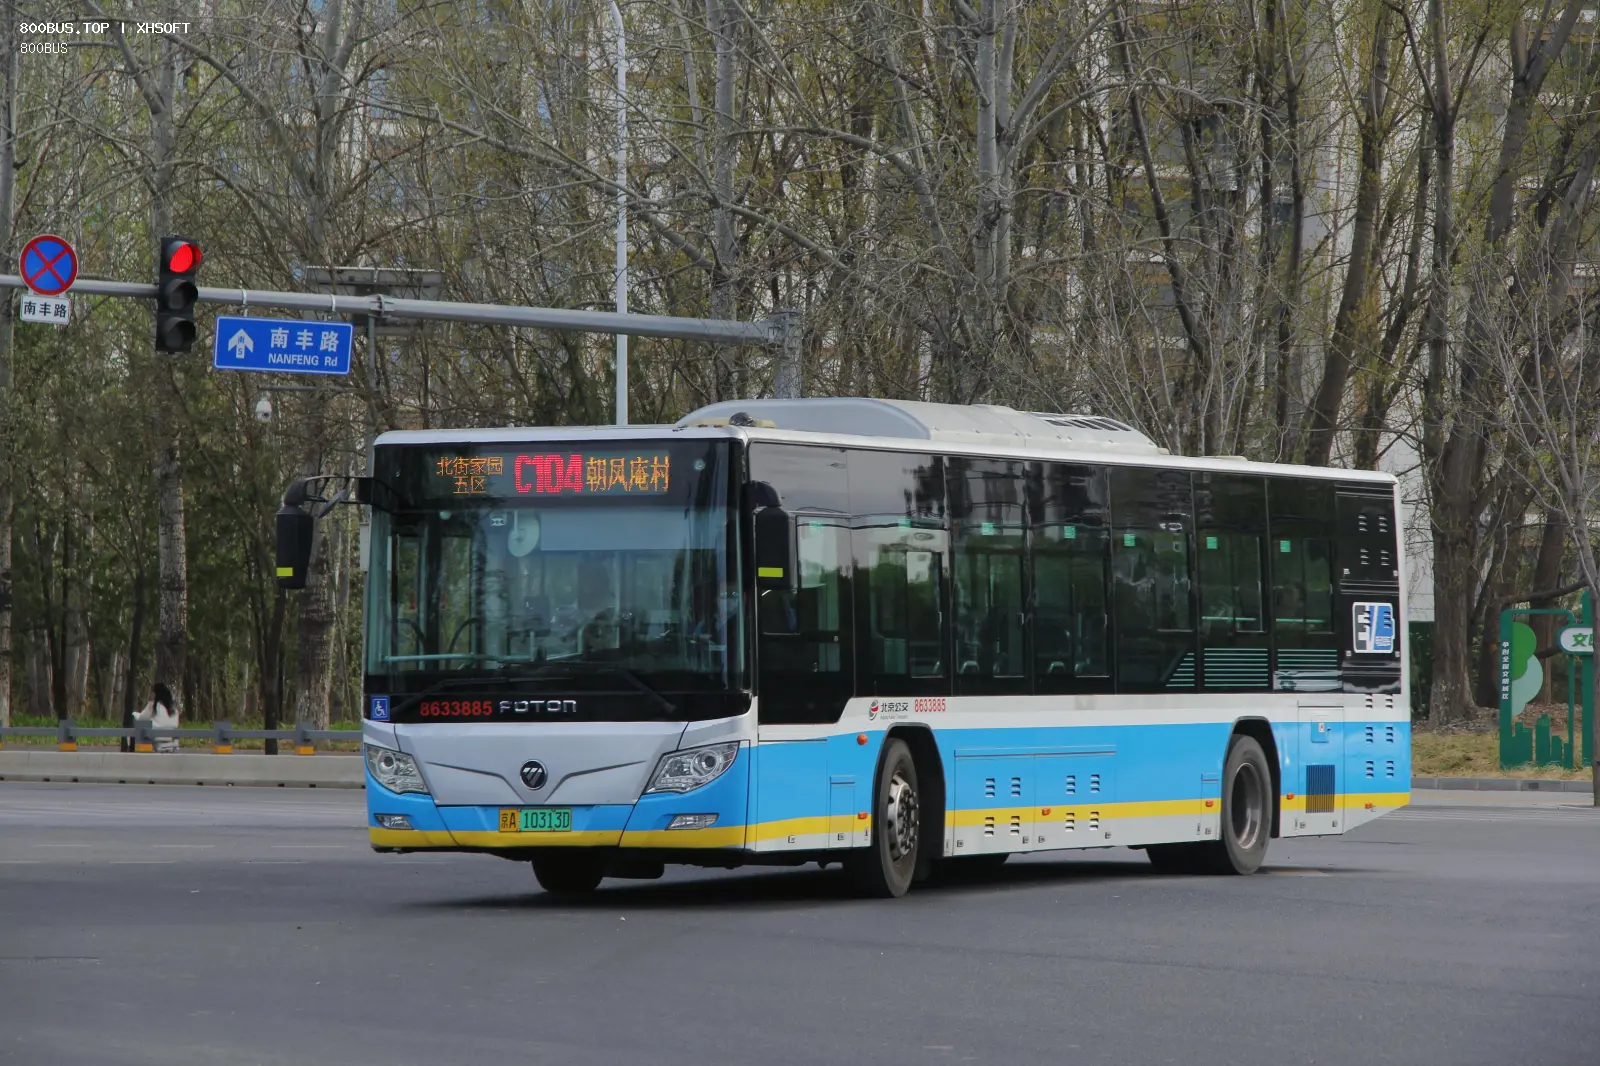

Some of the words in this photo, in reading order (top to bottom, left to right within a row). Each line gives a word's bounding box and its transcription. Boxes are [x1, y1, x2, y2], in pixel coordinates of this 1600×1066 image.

[24, 301, 67, 318] 南丰路
[270, 327, 339, 352] 南丰路
[268, 353, 319, 366] NANFENG
[324, 356, 338, 367] Rd
[436, 456, 503, 476] 北街家园
[514, 454, 583, 493] C104
[585, 455, 670, 492] 朝风庵村
[453, 476, 487, 494] 五区
[1571, 632, 1593, 648] 文
[420, 700, 493, 716] 8633885
[500, 700, 577, 713] FOTON
[881, 702, 909, 712] 北京公交
[914, 698, 946, 712] 8633885
